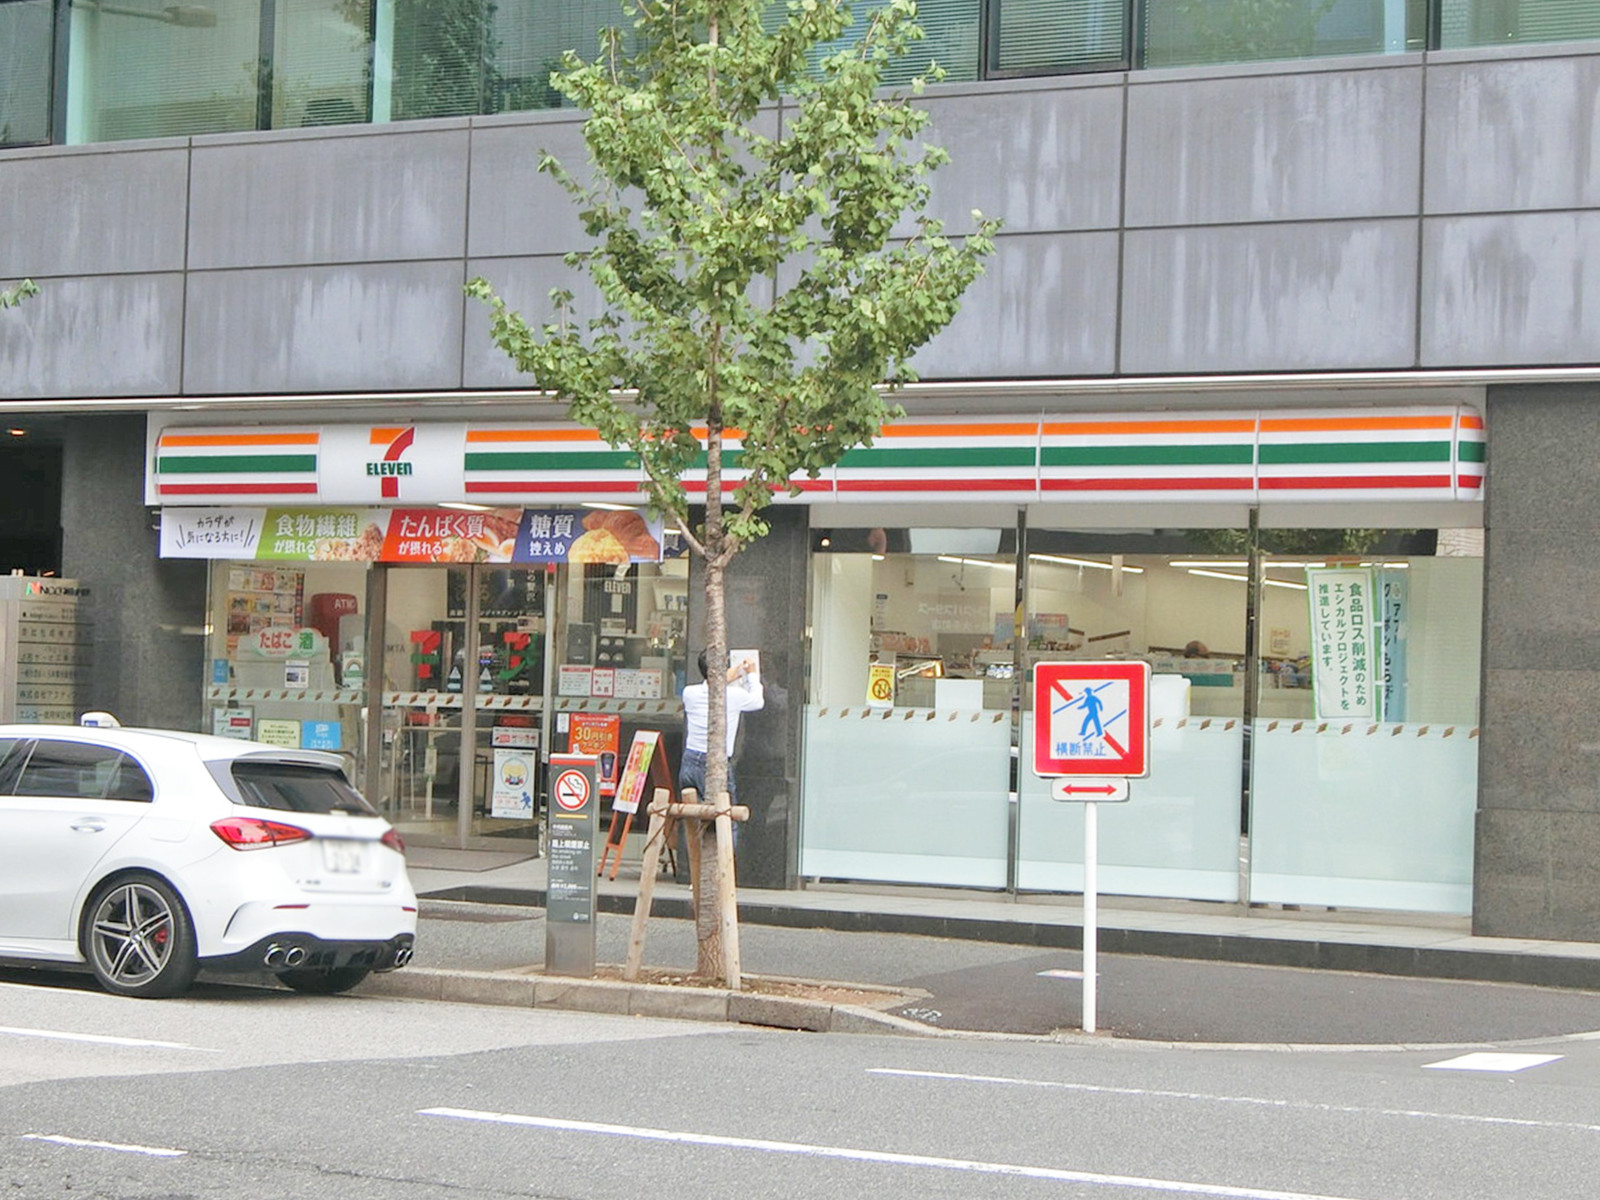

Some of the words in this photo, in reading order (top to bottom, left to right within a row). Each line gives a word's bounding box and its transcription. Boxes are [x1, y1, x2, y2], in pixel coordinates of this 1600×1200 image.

[197, 516, 235, 528] カラダが
[275, 514, 356, 537] 食物繊維
[530, 514, 574, 538] 糖質
[273, 540, 316, 553] が摂れる
[398, 541, 442, 555] が摂れる
[530, 541, 566, 556] 控えめ
[260, 632, 292, 648] たばこ
[299, 632, 314, 649] 酒
[1334, 583, 1350, 710] エシカルプロジェクトを
[1349, 582, 1366, 706] 食品ロス削減のため
[1056, 742, 1107, 756] 横断禁止
